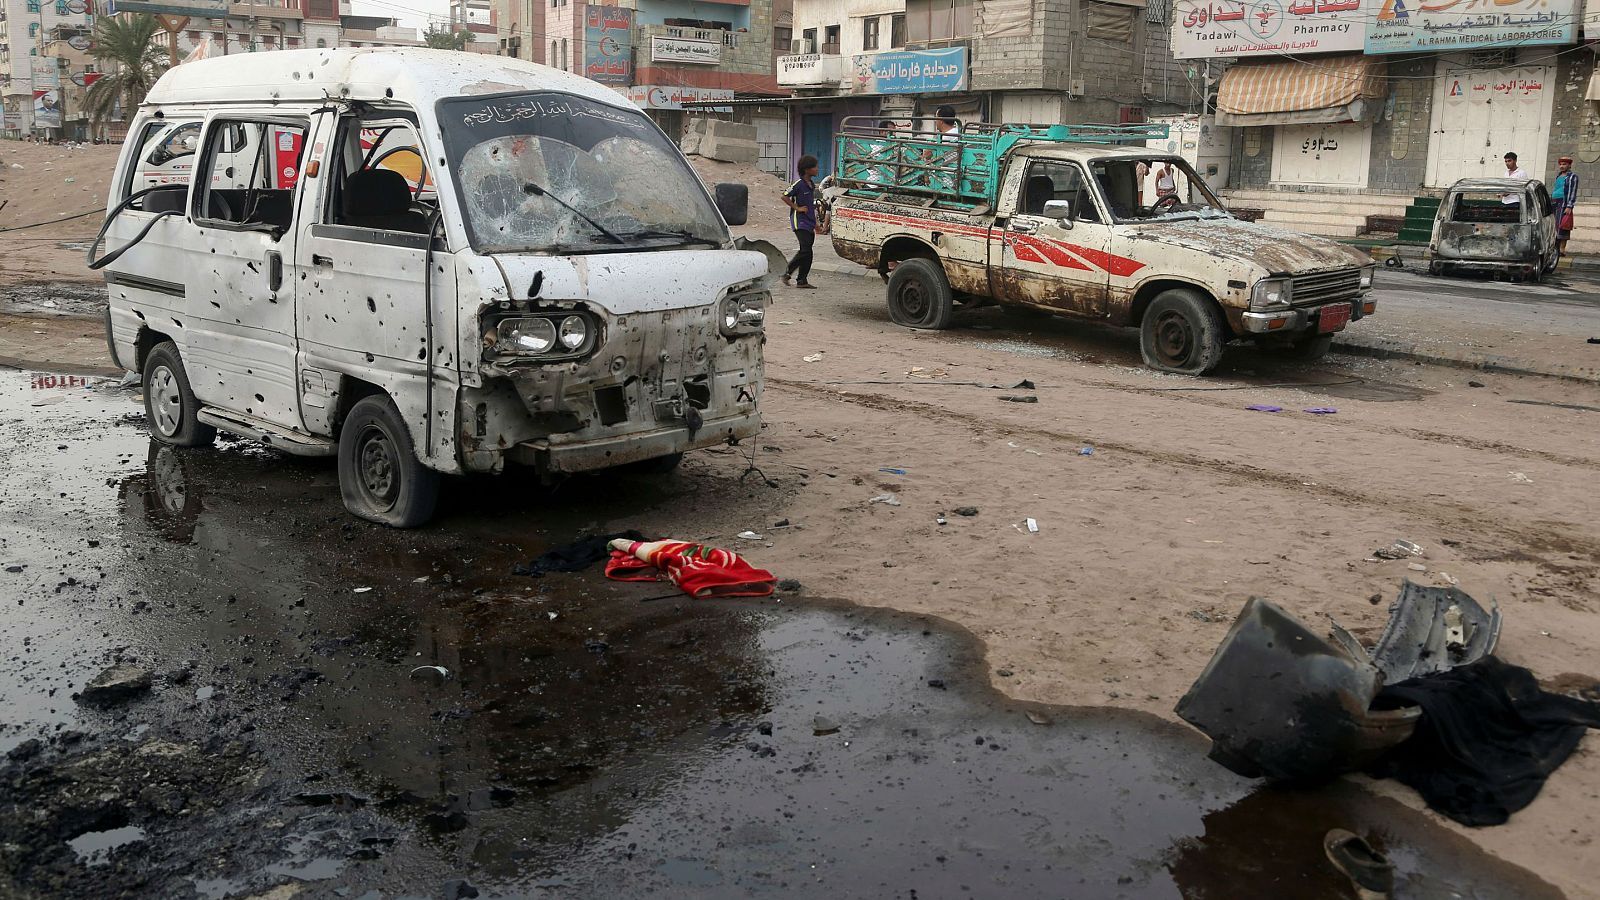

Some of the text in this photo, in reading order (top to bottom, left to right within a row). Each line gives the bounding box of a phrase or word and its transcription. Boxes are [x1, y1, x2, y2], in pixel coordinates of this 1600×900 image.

[1183, 2, 1245, 33] تداوي
[1424, 11, 1558, 34] الطبية التشخيصية
[1196, 23, 1350, 41] Tadawi Pharmacy
[1459, 34, 1494, 44] MEDICAL
[1497, 29, 1563, 41] LABORATORIES
[875, 60, 958, 81] صيدلية فارما لايف
[463, 105, 501, 128] الرحيم
[548, 101, 573, 118] الله
[1302, 137, 1338, 153] تداوي
